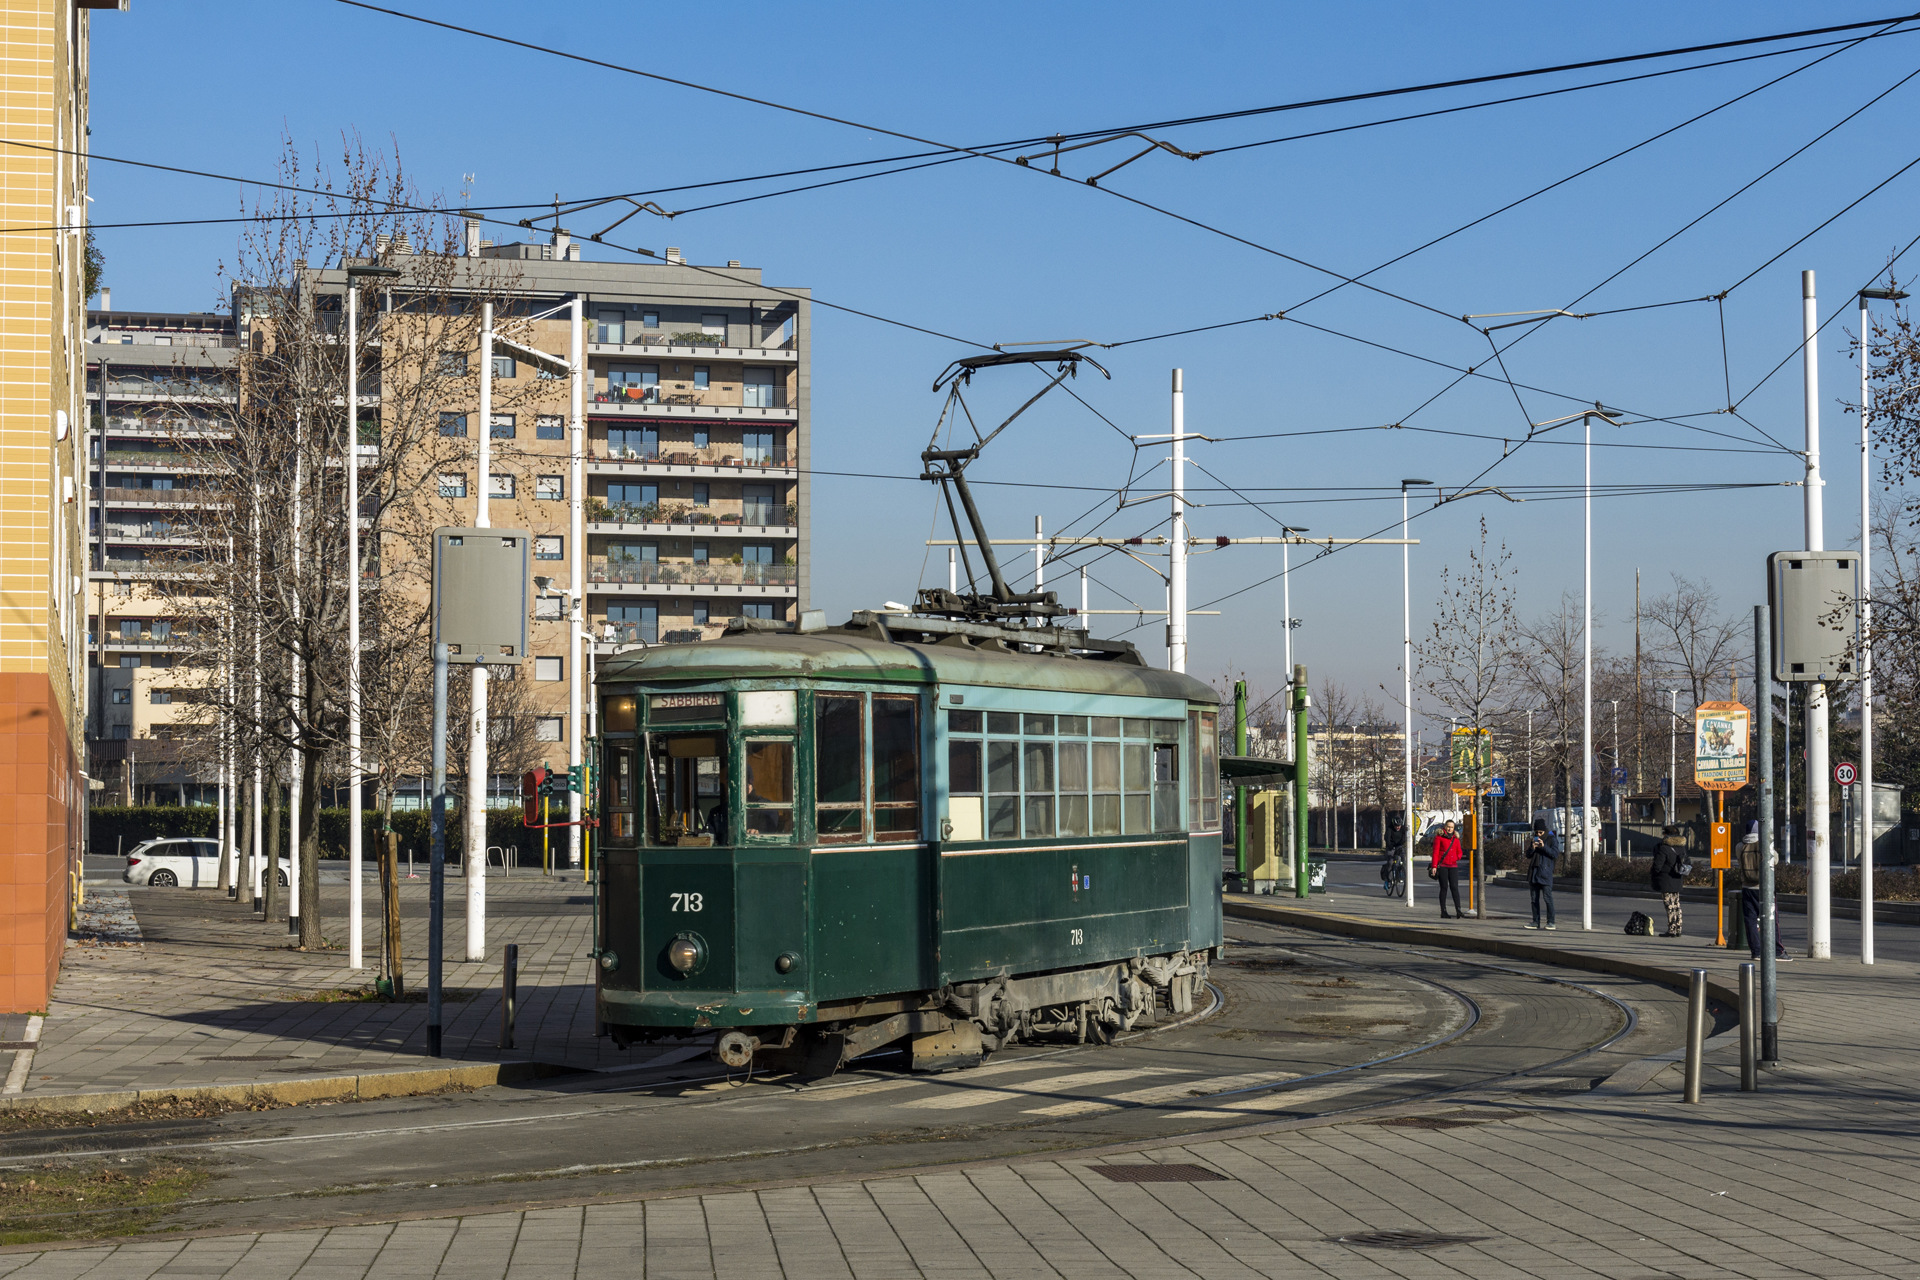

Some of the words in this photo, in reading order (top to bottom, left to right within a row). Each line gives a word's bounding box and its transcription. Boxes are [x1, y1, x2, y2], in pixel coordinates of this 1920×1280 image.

[661, 694, 719, 707] SABBIERA
[1706, 720, 1731, 729] CAVANNA
[1839, 769, 1852, 779] 30
[670, 892, 703, 912] 713
[1071, 928, 1083, 945] 713
